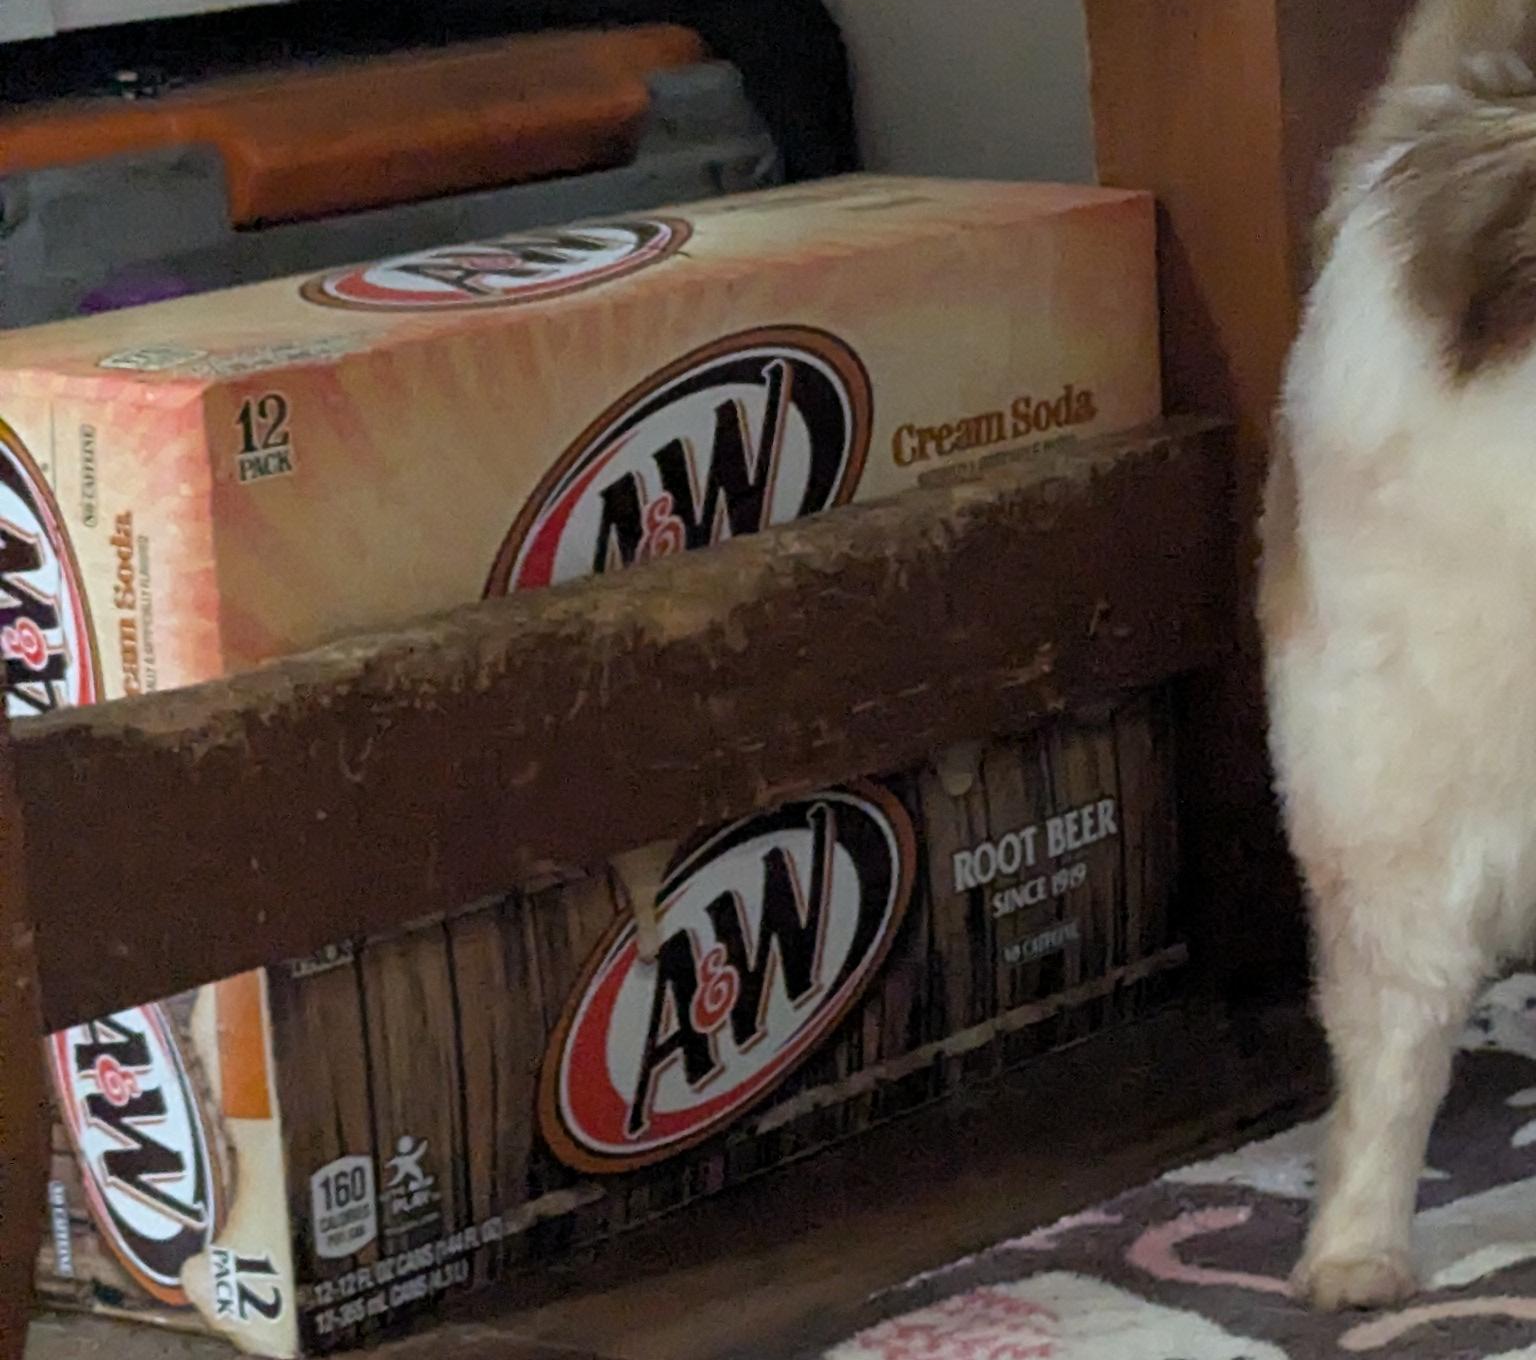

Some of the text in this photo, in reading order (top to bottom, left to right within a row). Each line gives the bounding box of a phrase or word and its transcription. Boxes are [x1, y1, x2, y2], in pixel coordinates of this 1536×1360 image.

[235, 393, 290, 454] 12
[892, 410, 1007, 468] Cream
[1010, 384, 1099, 439] Soda
[238, 451, 293, 481] PACK
[109, 509, 136, 610] Soda
[953, 798, 1119, 894] ROOT BEER
[992, 862, 1088, 919] SINCE 1919
[626, 801, 837, 1139] A&W
[319, 1165, 367, 1212] 160
[212, 1248, 236, 1321] PACK
[234, 1254, 283, 1321] 12
